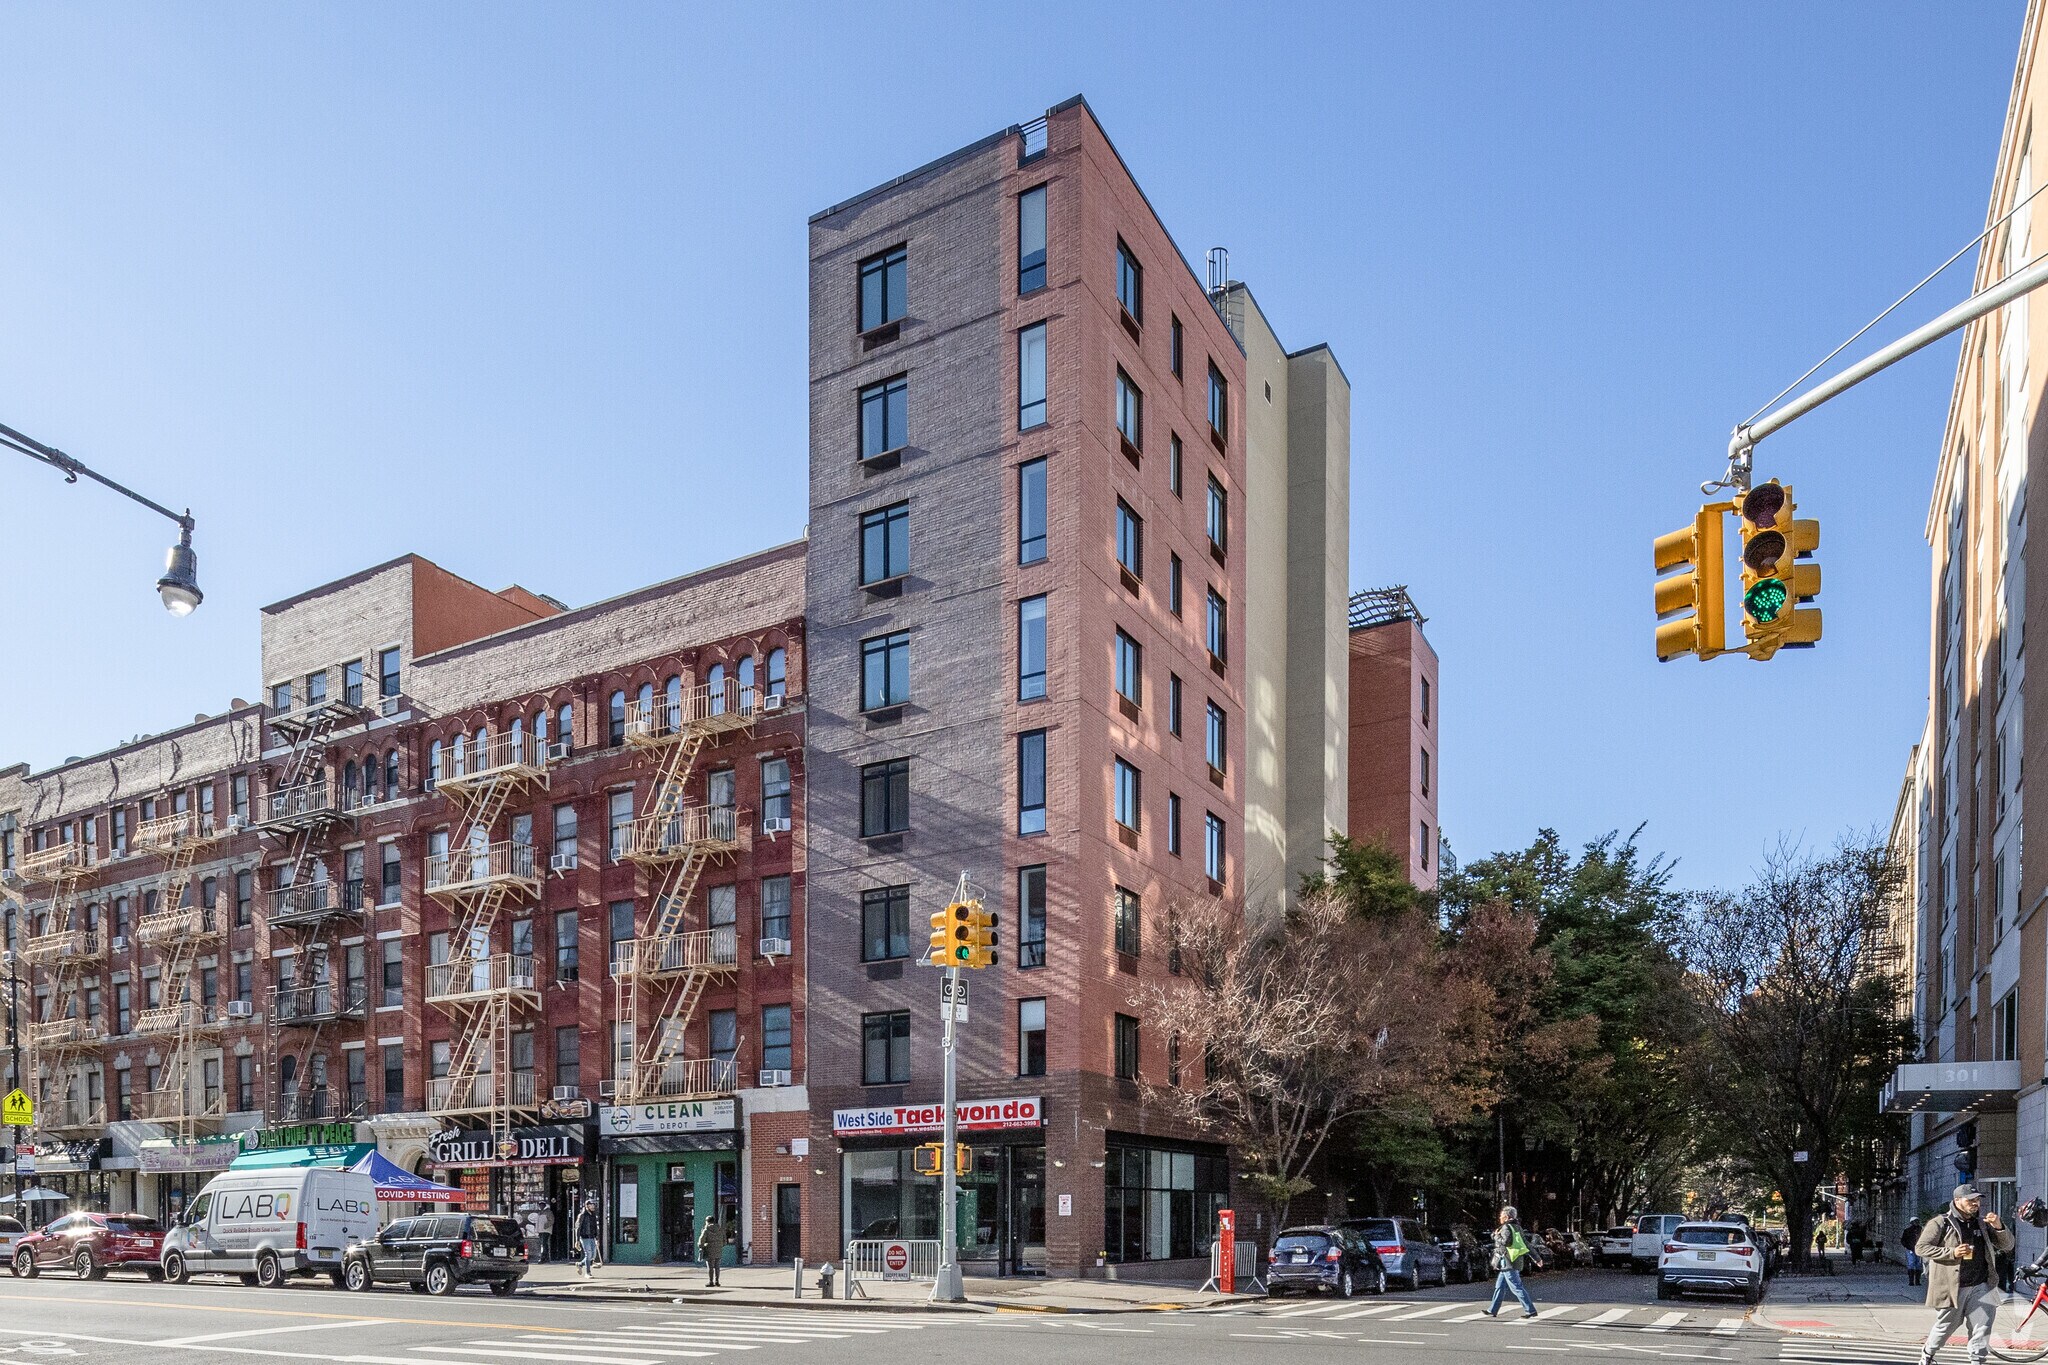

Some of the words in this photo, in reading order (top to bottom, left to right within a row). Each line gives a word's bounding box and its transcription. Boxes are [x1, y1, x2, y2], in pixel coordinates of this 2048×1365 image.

[1945, 1069, 1978, 1083] 301
[5, 1115, 31, 1123] SCHOOL
[645, 1103, 703, 1120] CLEAN
[837, 1113, 865, 1128] West
[867, 1111, 893, 1126] Side
[894, 1101, 1035, 1124] Taekwondo
[323, 1122, 353, 1144] PEACE
[660, 1121, 688, 1130] DEPOT
[429, 1125, 461, 1147] Fresh
[436, 1140, 494, 1163] GRILL
[521, 1136, 570, 1159] DELI
[377, 1190, 416, 1198] COVID-19
[417, 1191, 450, 1200] TESTING
[222, 1193, 291, 1220] LABQ
[317, 1197, 370, 1216] LABQ
